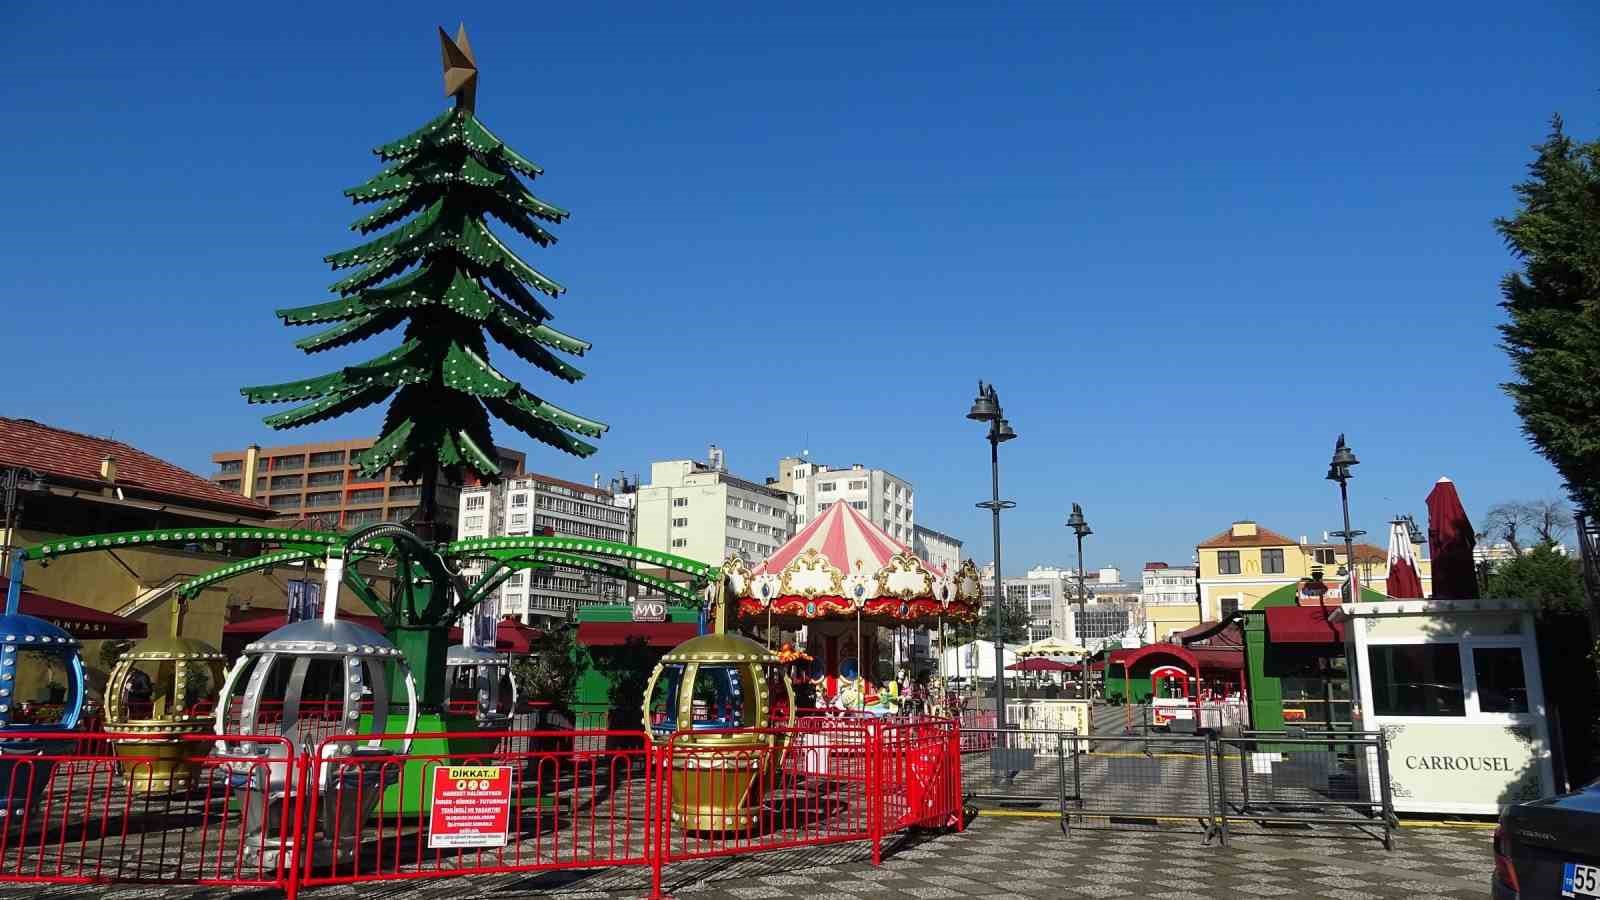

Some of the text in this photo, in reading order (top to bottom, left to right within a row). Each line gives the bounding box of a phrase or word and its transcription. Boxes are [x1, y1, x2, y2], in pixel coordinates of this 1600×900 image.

[635, 603, 664, 616] MAD
[1405, 755, 1514, 771] CARROUSEL
[1574, 866, 1597, 891] 55
